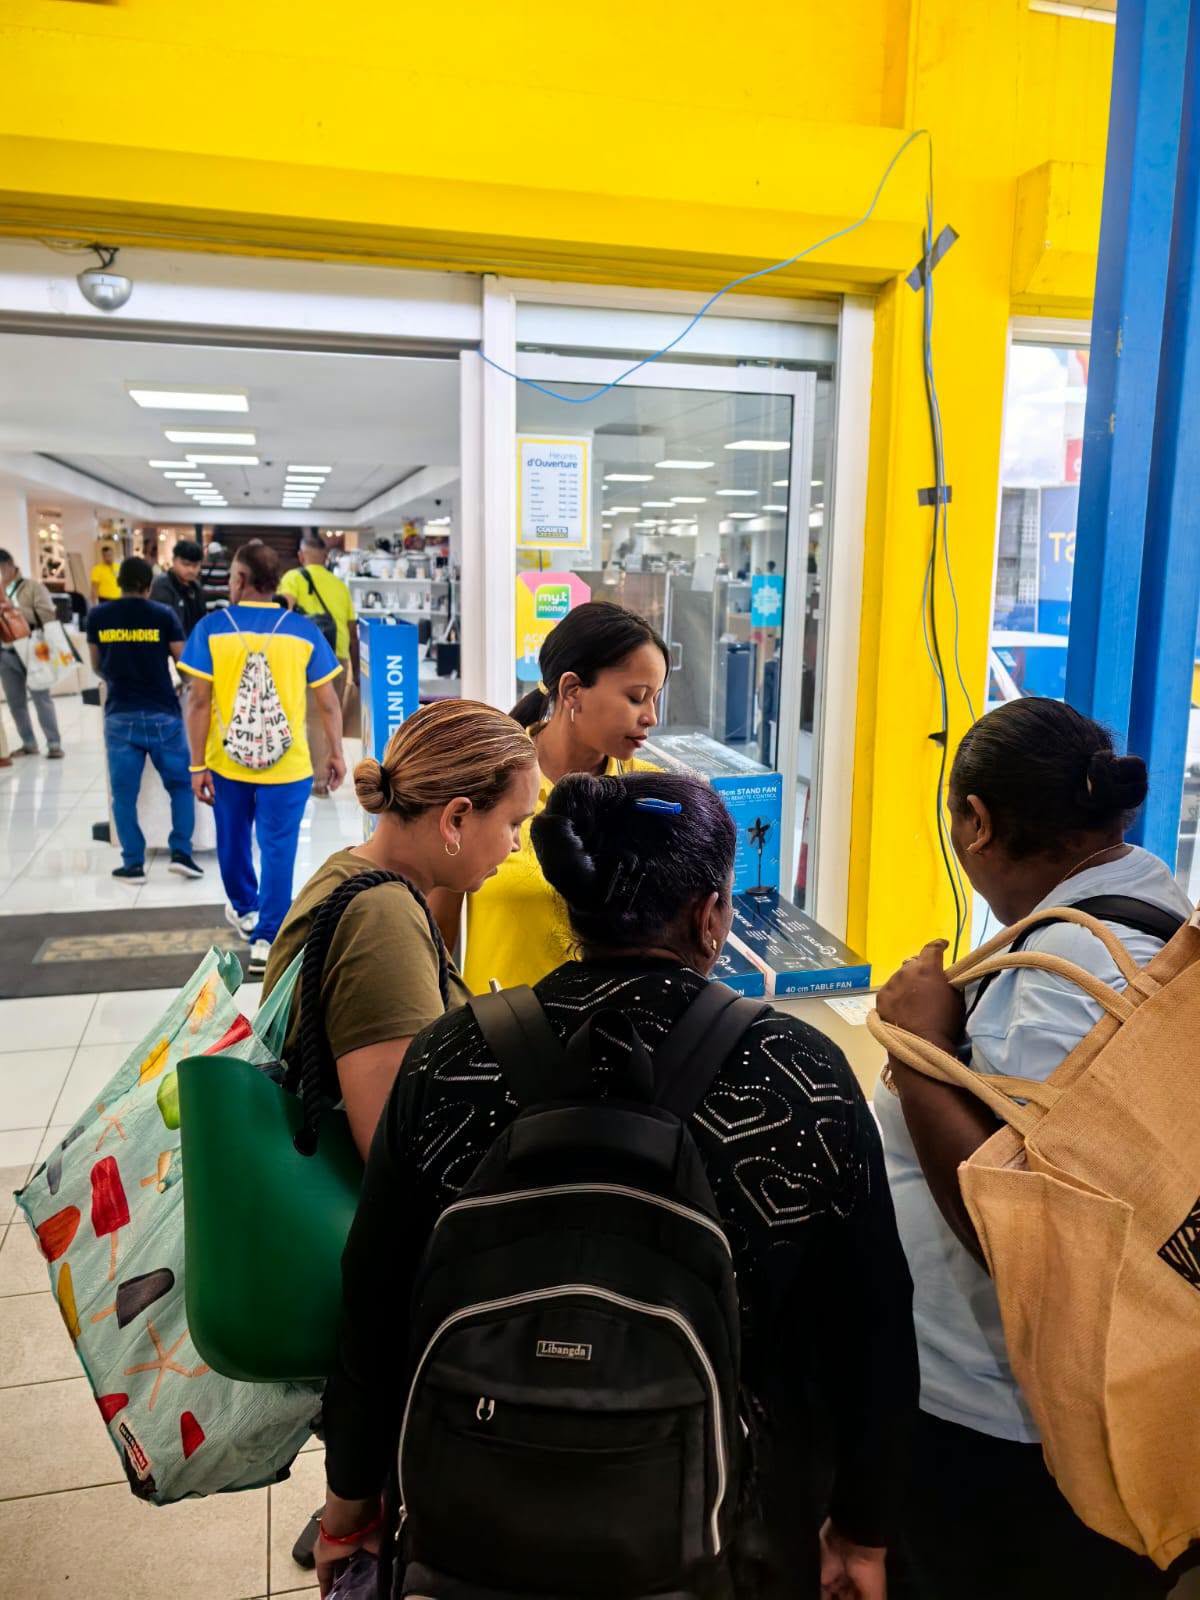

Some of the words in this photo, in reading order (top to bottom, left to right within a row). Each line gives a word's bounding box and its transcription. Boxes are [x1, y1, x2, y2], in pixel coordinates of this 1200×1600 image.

[526, 458, 578, 469] d'Ouverture
[538, 605, 567, 613] money
[98, 628, 160, 642] MERCHANDISE
[386, 655, 404, 686] NO
[737, 788, 761, 796] STAND
[810, 983, 834, 991] TABLE
[836, 981, 853, 989] FAN
[542, 1343, 586, 1357] Libangda
